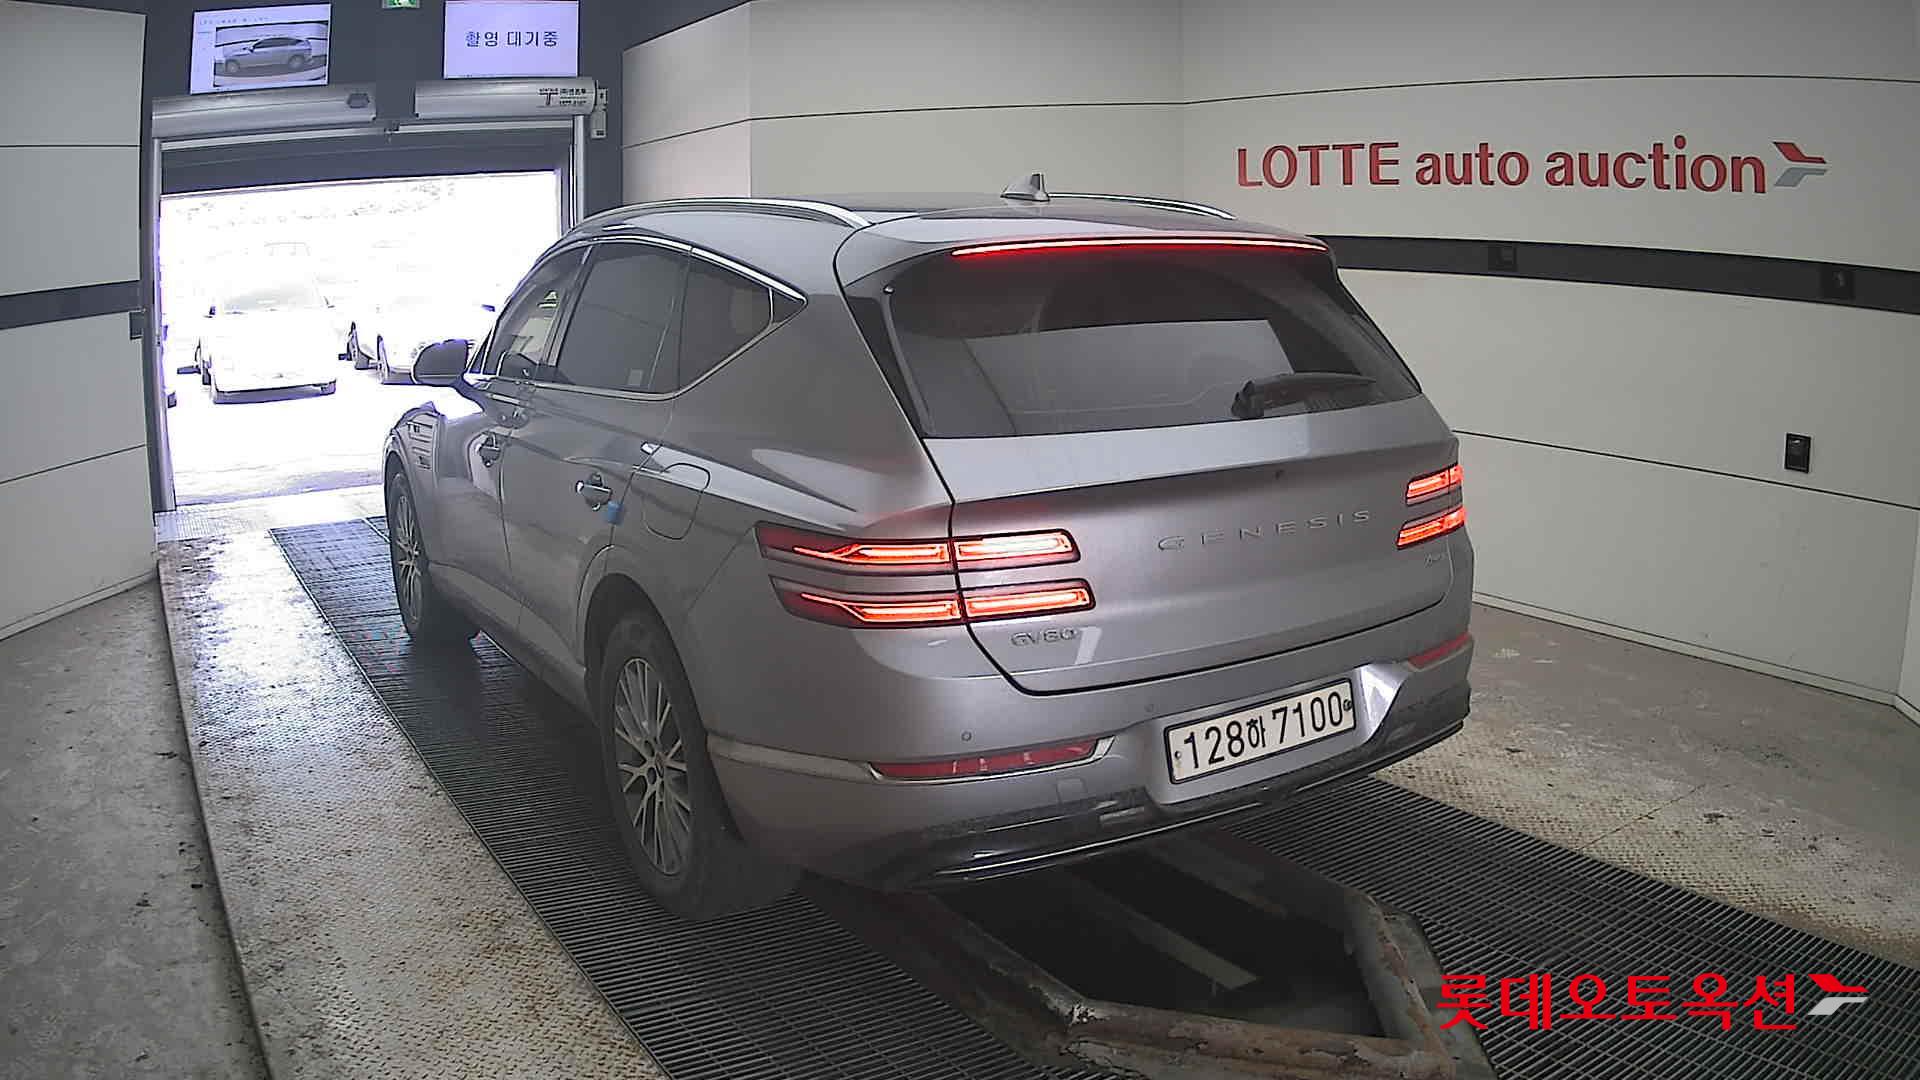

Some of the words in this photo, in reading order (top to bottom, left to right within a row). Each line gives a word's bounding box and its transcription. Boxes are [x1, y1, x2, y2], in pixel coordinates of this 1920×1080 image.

[506, 31, 559, 47] 대기중
[1237, 142, 1400, 188] LOTTE
[1415, 143, 1529, 187] auto
[1545, 135, 1767, 194] auction
[1157, 510, 1370, 551] GENESIS
[1183, 715, 1266, 769] 128하
[1271, 691, 1343, 744] 7100
